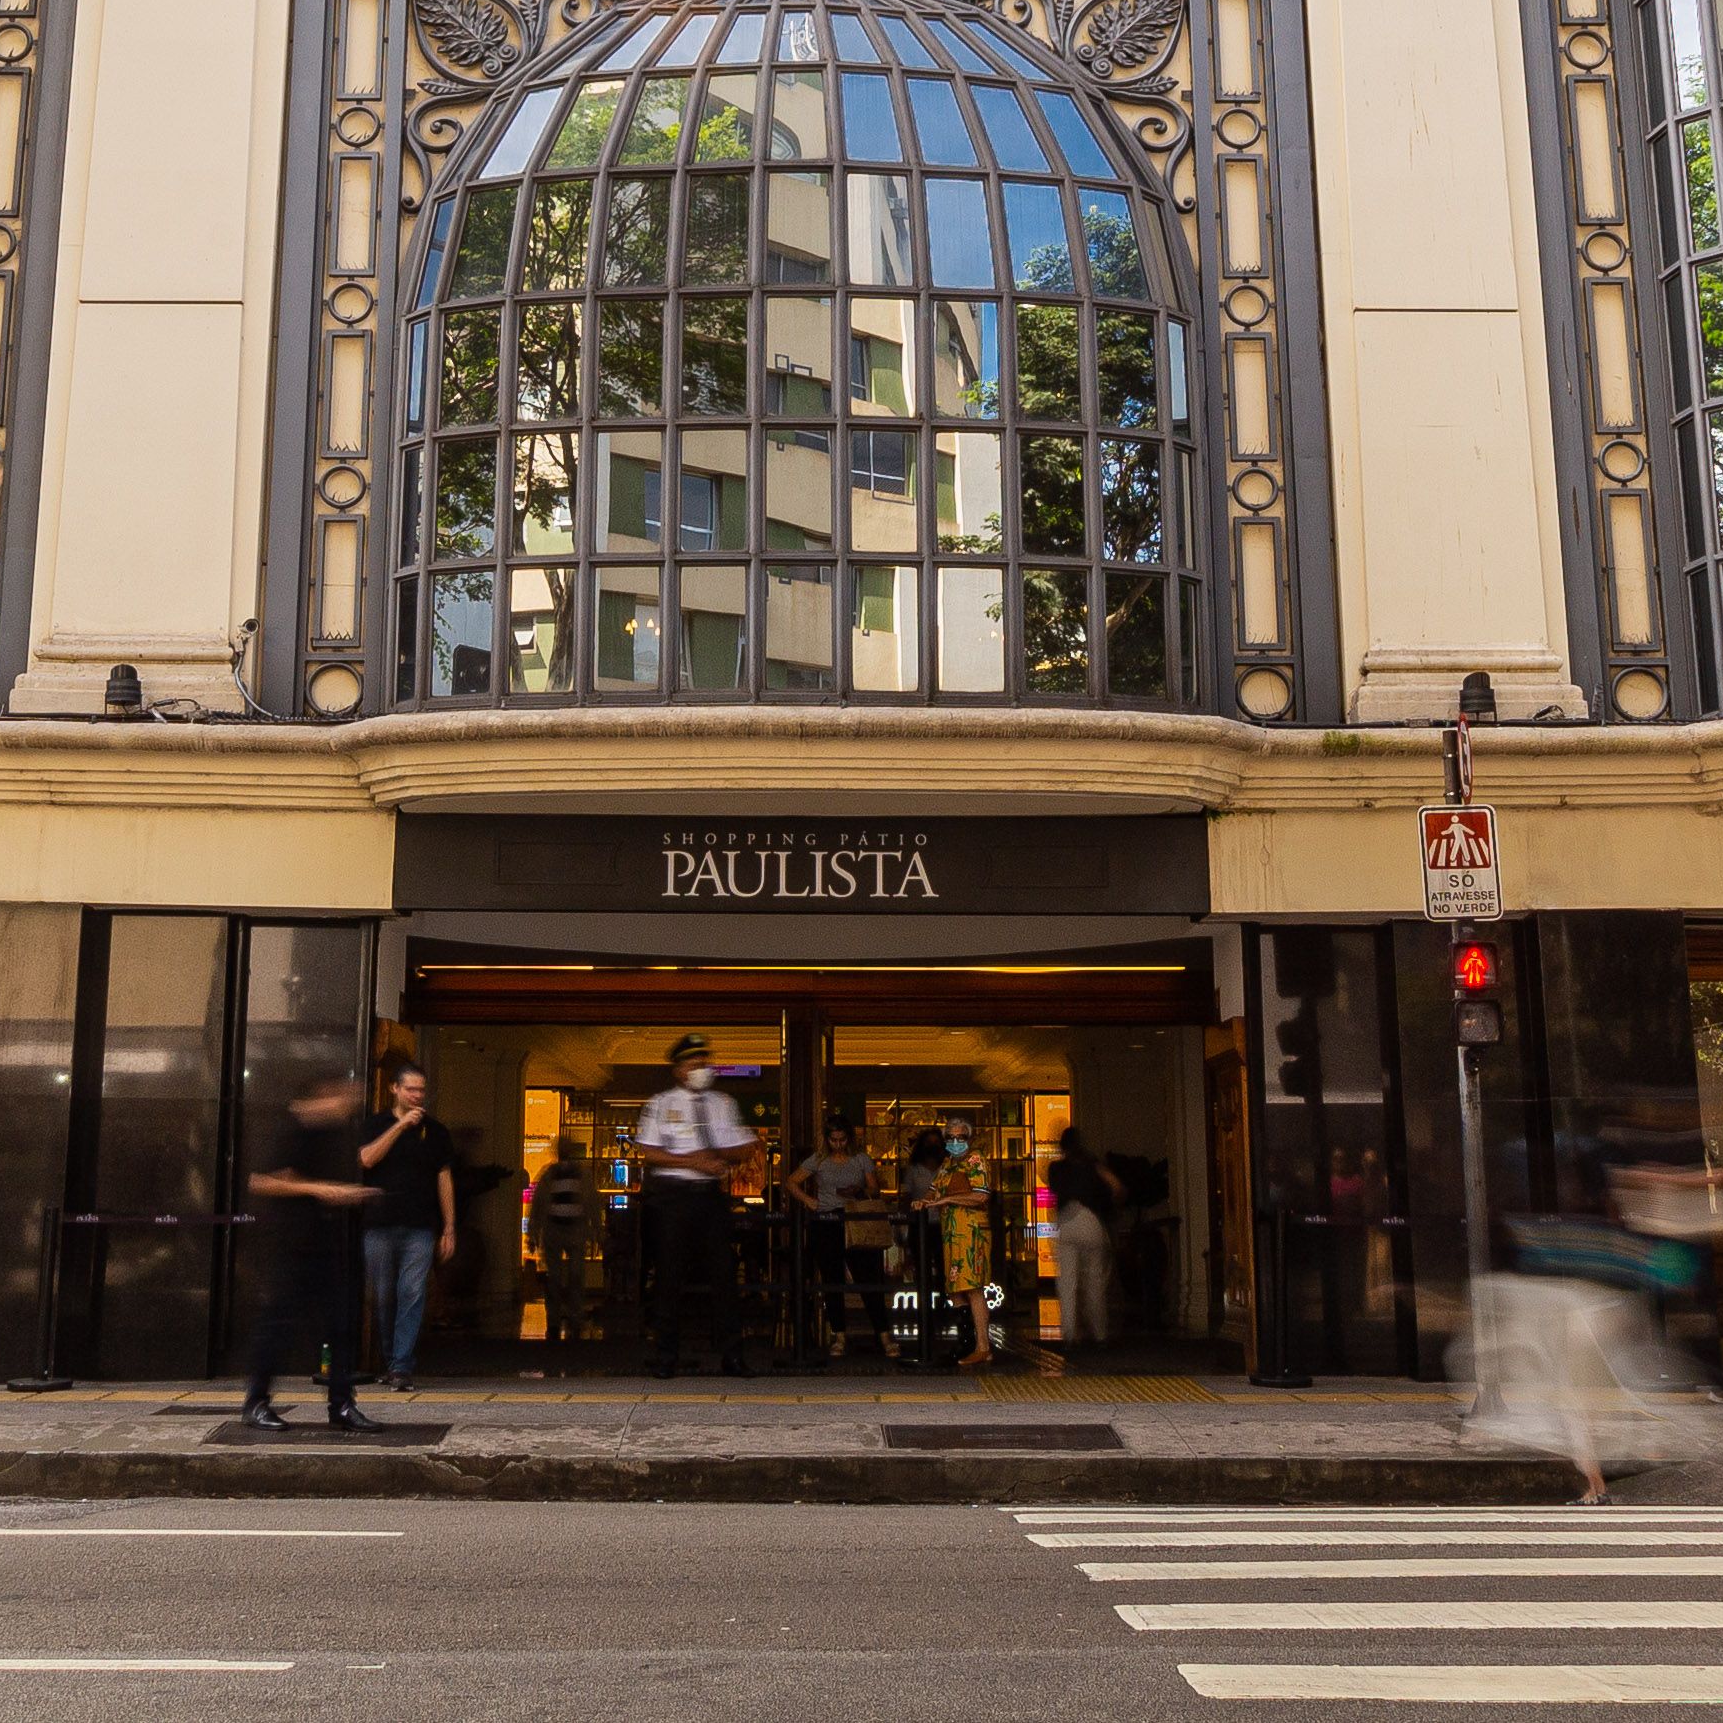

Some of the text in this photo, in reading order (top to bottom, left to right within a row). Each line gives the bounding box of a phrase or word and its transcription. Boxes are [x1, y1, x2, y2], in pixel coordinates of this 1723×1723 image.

[663, 830, 927, 846] SHOPPING PÁTIO
[661, 849, 940, 898] PAULISTA
[1449, 870, 1475, 888] SÓ
[1431, 890, 1495, 902] ATRAVESSE
[1433, 902, 1495, 914] NO VERDE
